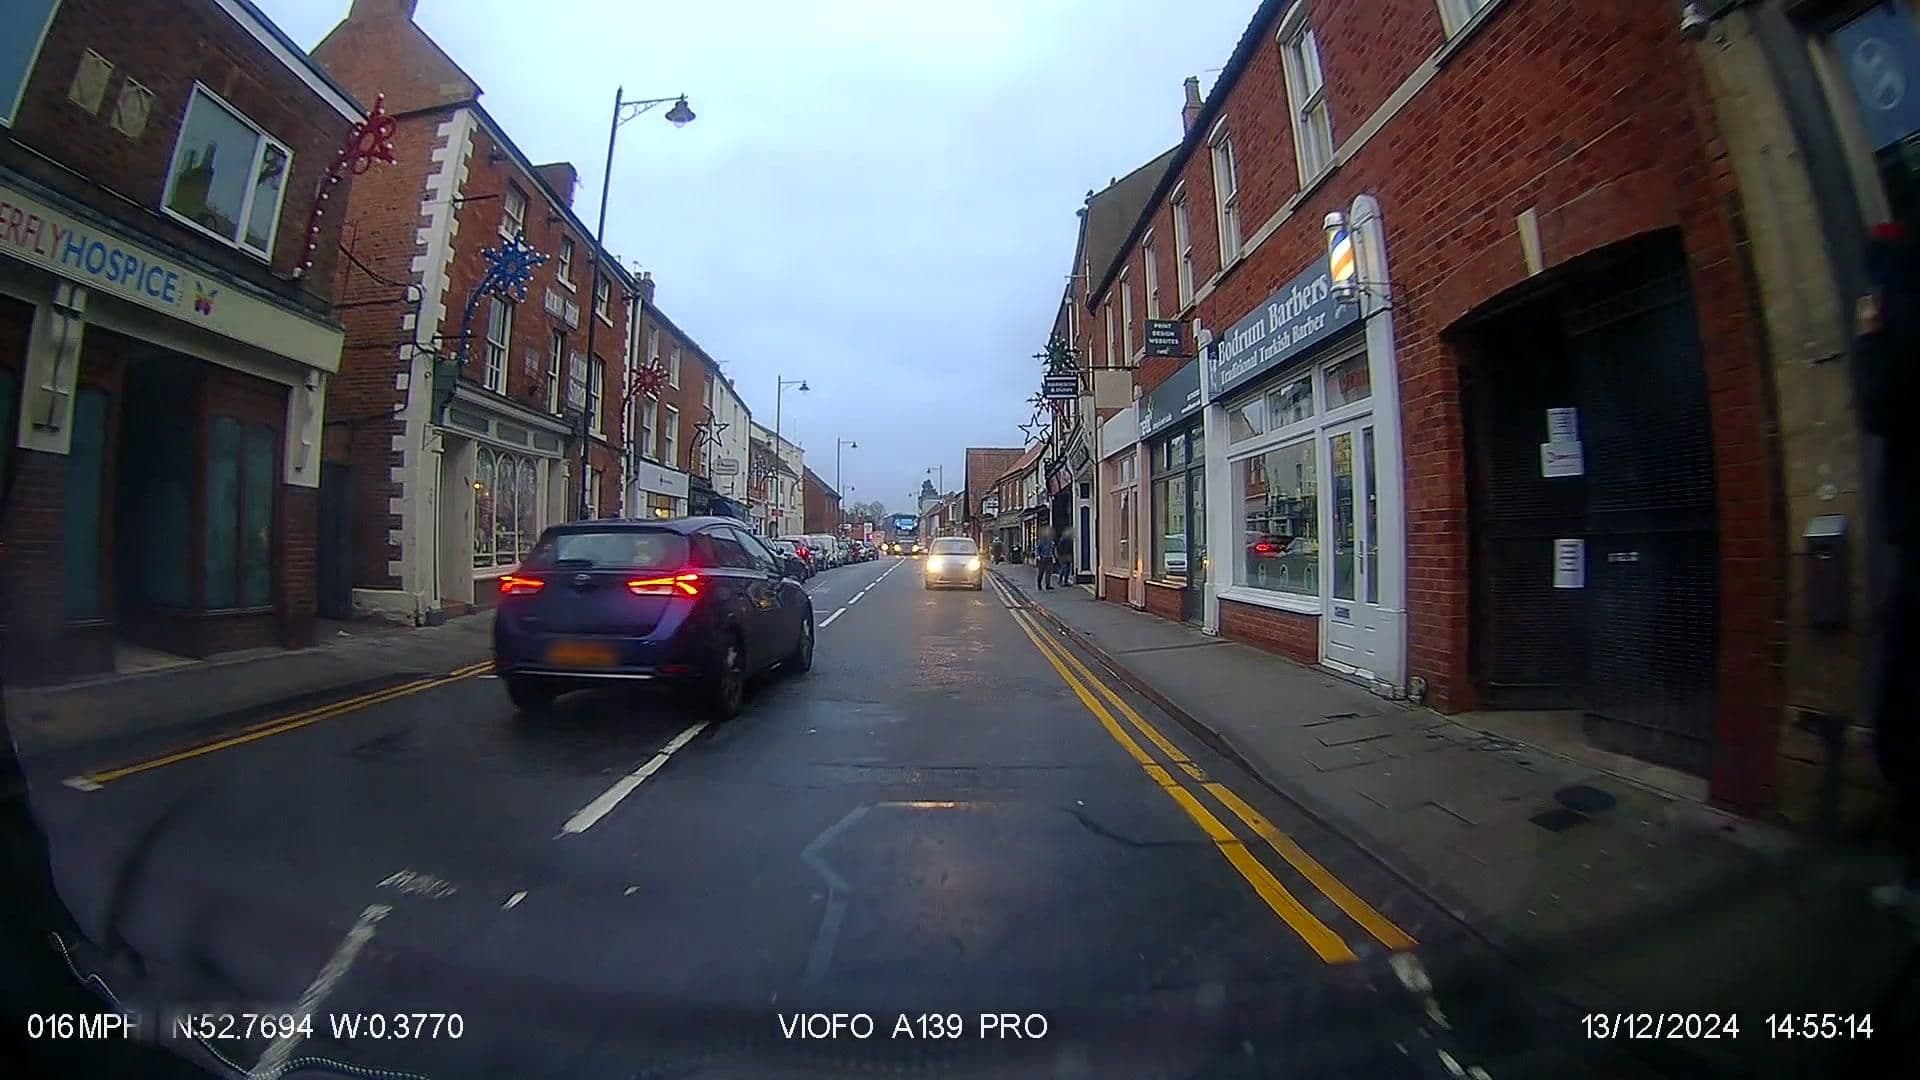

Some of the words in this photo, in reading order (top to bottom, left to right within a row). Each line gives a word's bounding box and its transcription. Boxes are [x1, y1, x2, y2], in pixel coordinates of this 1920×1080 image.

[62, 228, 179, 303] HOSPICE
[1218, 319, 1266, 367] Bodrum
[1268, 273, 1328, 334] Barbers
[1221, 350, 1258, 385] Traditional
[1259, 330, 1291, 363] Turkish
[1292, 311, 1326, 345] Barber
